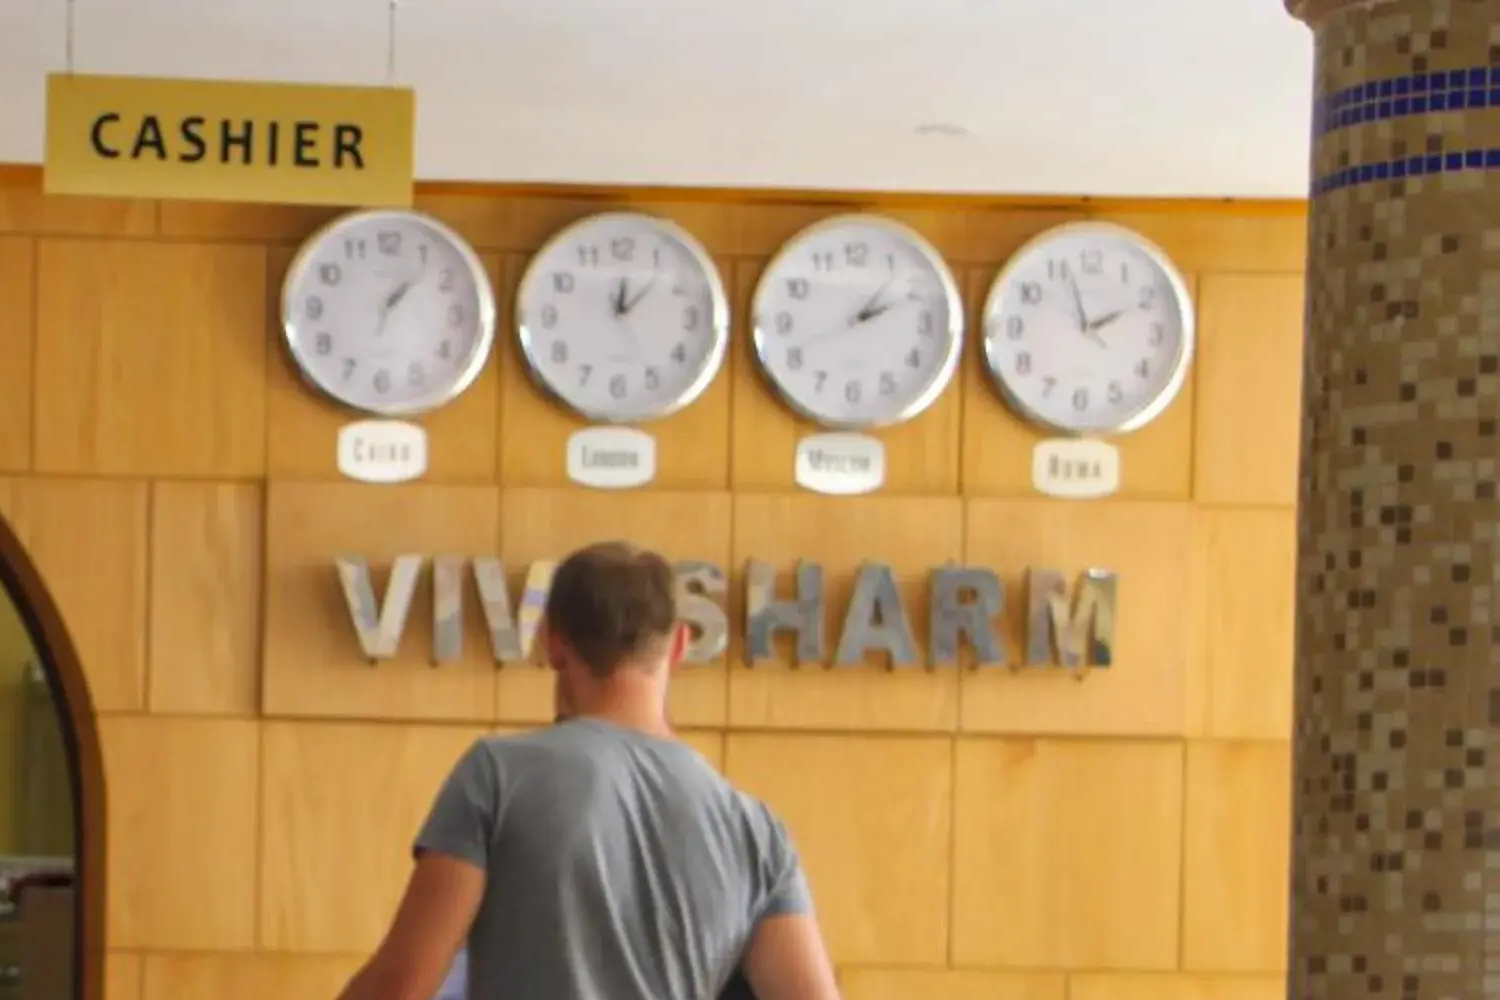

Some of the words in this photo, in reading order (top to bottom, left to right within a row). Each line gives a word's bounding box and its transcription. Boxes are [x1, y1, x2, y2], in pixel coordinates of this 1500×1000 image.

[89, 112, 366, 170] CASHIER
[345, 238, 366, 260] 11
[377, 230, 401, 256] 12
[417, 243, 428, 265] 1
[577, 244, 598, 267] 11
[611, 236, 636, 262] 12
[844, 241, 868, 267] 12
[651, 247, 661, 269] 1
[812, 251, 833, 272] 11
[885, 252, 895, 273] 1
[1047, 258, 1068, 282] 11
[1080, 249, 1103, 274] 12
[318, 262, 342, 286] 10
[552, 271, 575, 294] 10
[1119, 261, 1129, 283] 1
[787, 278, 810, 301] 10
[1020, 280, 1042, 305] 10
[1137, 284, 1155, 310] 2
[541, 303, 558, 330] 9
[684, 305, 698, 331] 3
[776, 311, 793, 336] 9
[918, 309, 933, 337] 3
[1007, 314, 1023, 341] 9
[316, 332, 332, 355] 8
[1148, 322, 1164, 348] 3
[551, 339, 567, 364] 8
[670, 341, 686, 363] 4
[786, 346, 803, 370] 8
[904, 347, 920, 369] 4
[343, 358, 356, 380] 7
[578, 364, 593, 387] 7
[1015, 352, 1031, 377] 8
[1133, 357, 1148, 378] 4
[373, 369, 390, 394] 6
[609, 373, 626, 400] 6
[644, 366, 660, 391] 5
[813, 369, 828, 393] 7
[879, 370, 897, 396] 5
[1041, 376, 1056, 398] 7
[844, 379, 861, 405] 6
[1072, 386, 1089, 412] 6
[1108, 380, 1123, 404] 5
[334, 554, 556, 666] VIV
[667, 556, 1119, 670] SHARM
